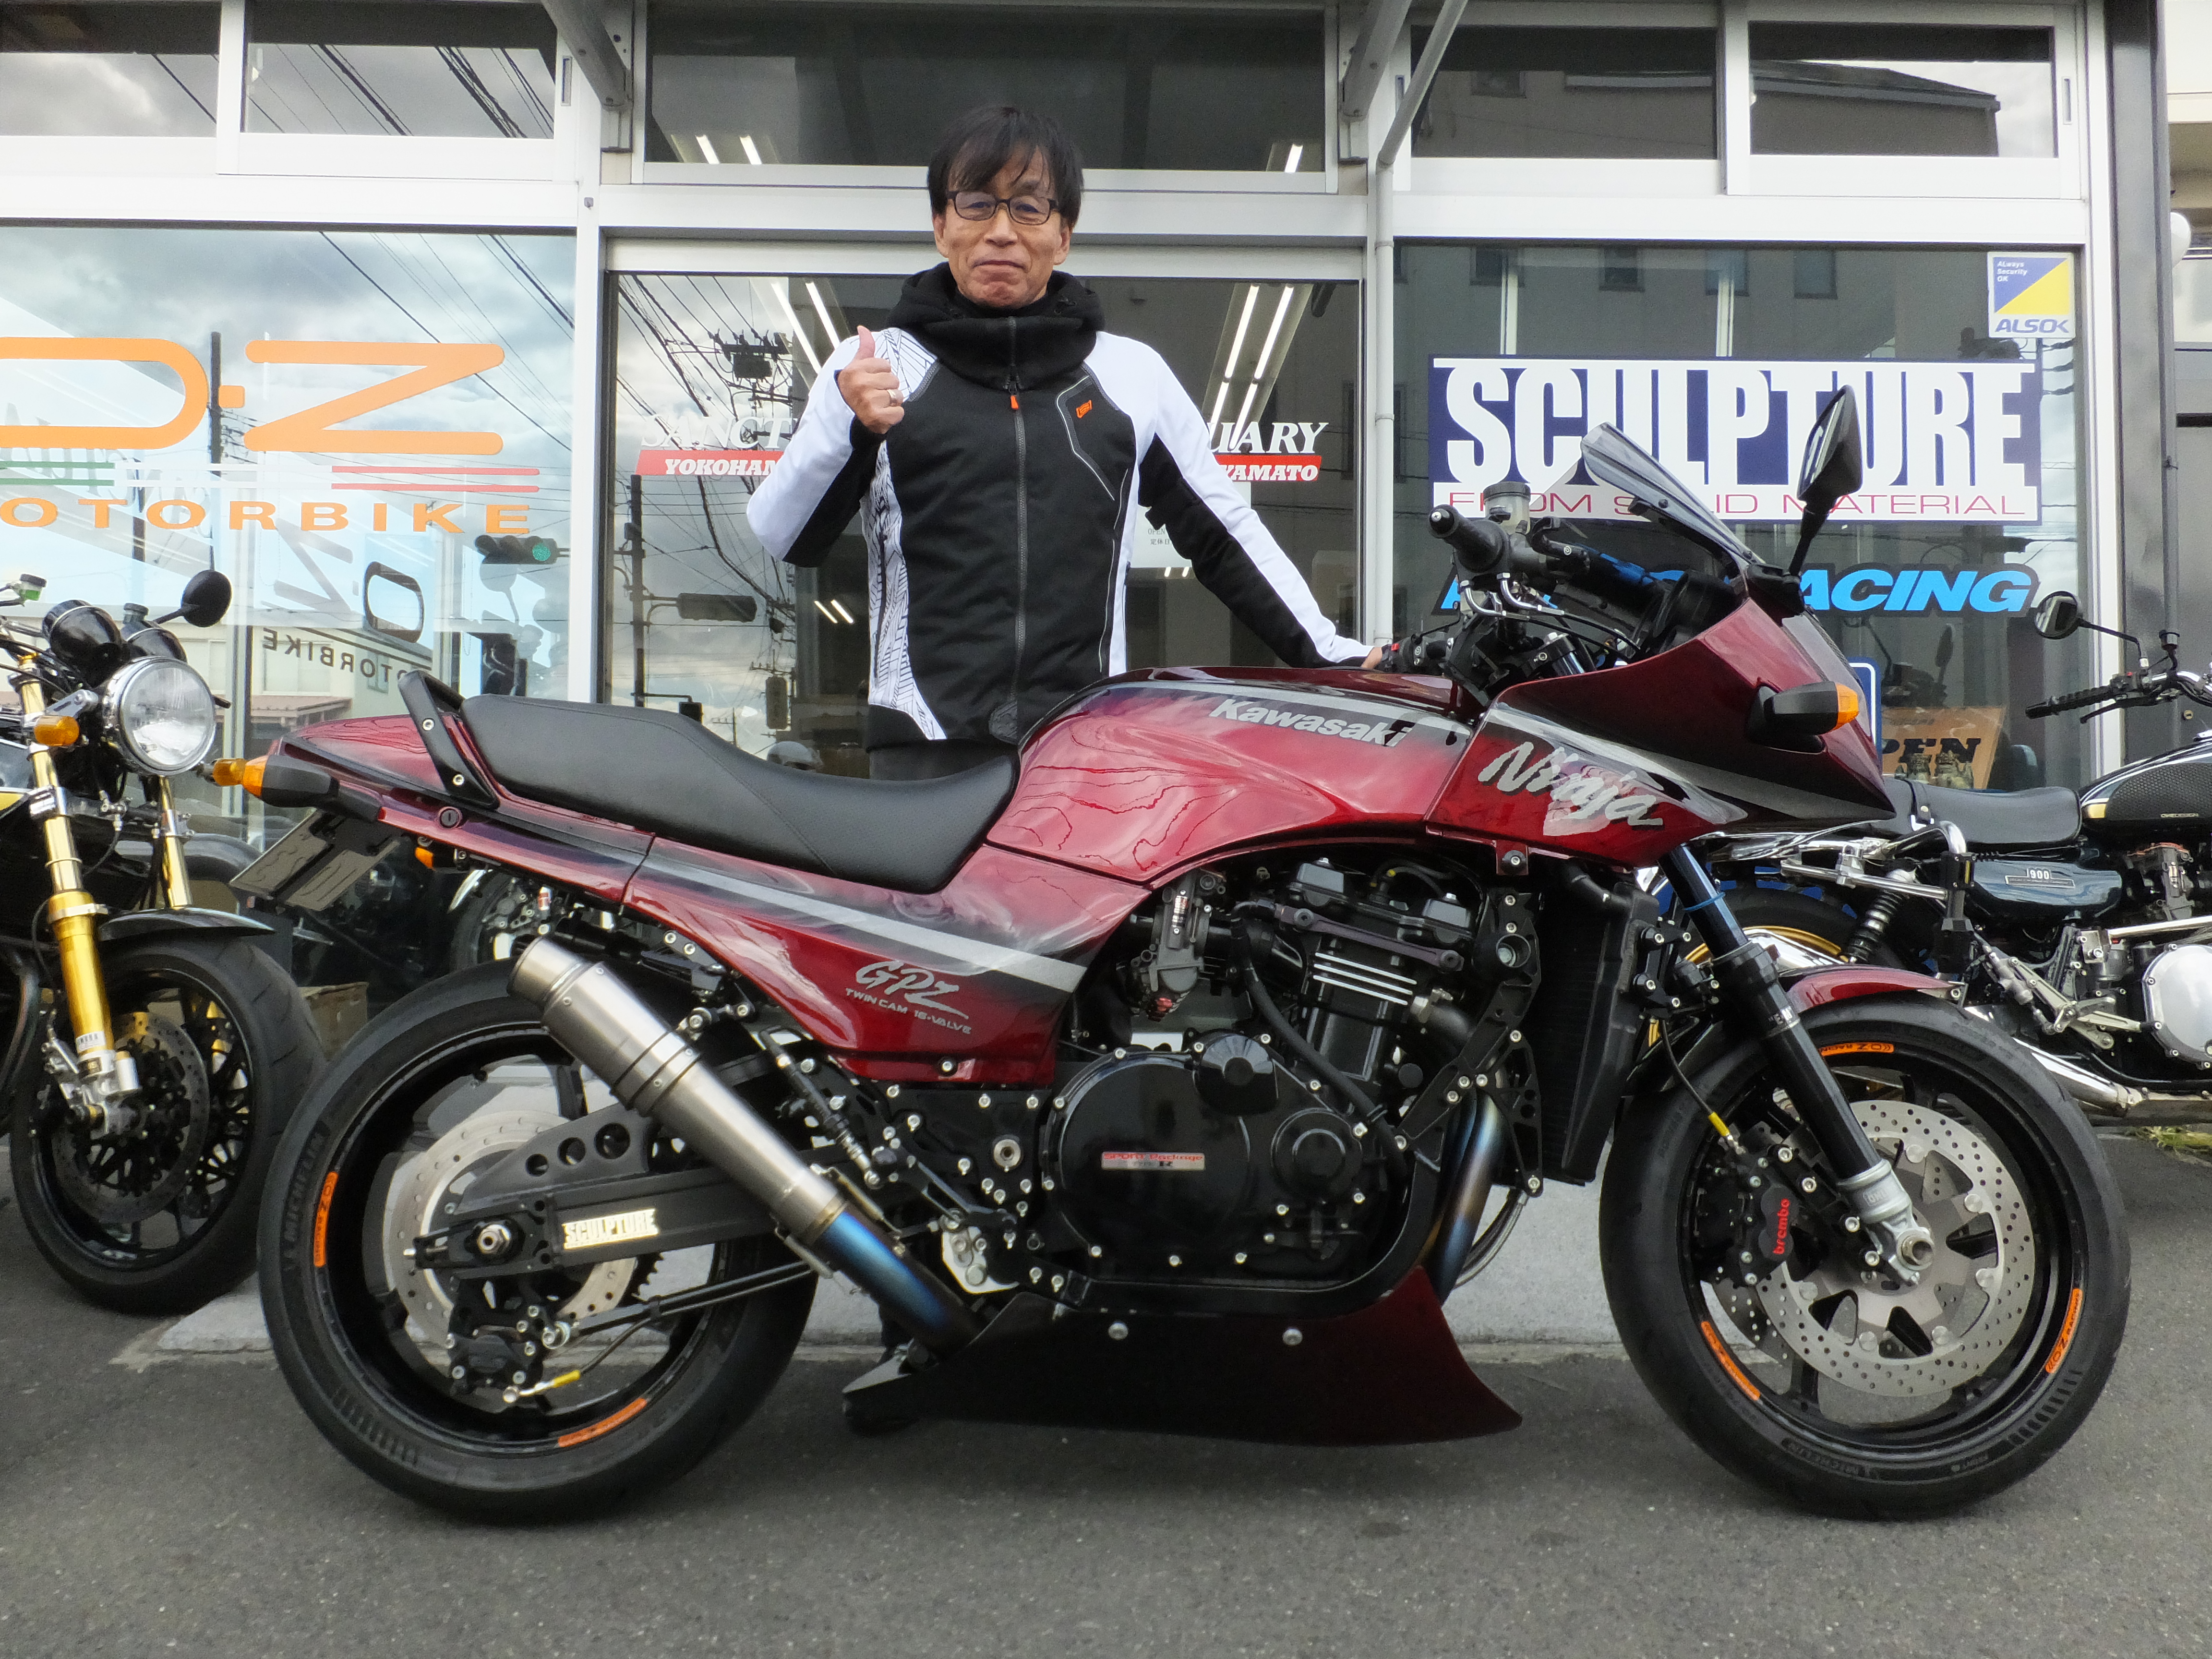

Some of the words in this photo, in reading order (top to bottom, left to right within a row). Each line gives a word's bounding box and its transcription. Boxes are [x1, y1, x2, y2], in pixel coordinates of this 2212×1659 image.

[1997, 268, 2028, 276] Security
[1995, 319, 2069, 333] ALSOK
[1446, 361, 2024, 486] SCULPTURE
[1449, 492, 1593, 513] FM
[1801, 569, 2032, 612] ACING
[1209, 698, 1413, 747] Kawasaki
[2030, 869, 2050, 880] 900
[845, 987, 878, 1005] TWIN
[878, 998, 908, 1014] CAM
[562, 1208, 660, 1247] SCULPTURE
[1773, 1198, 1790, 1254] brembo
